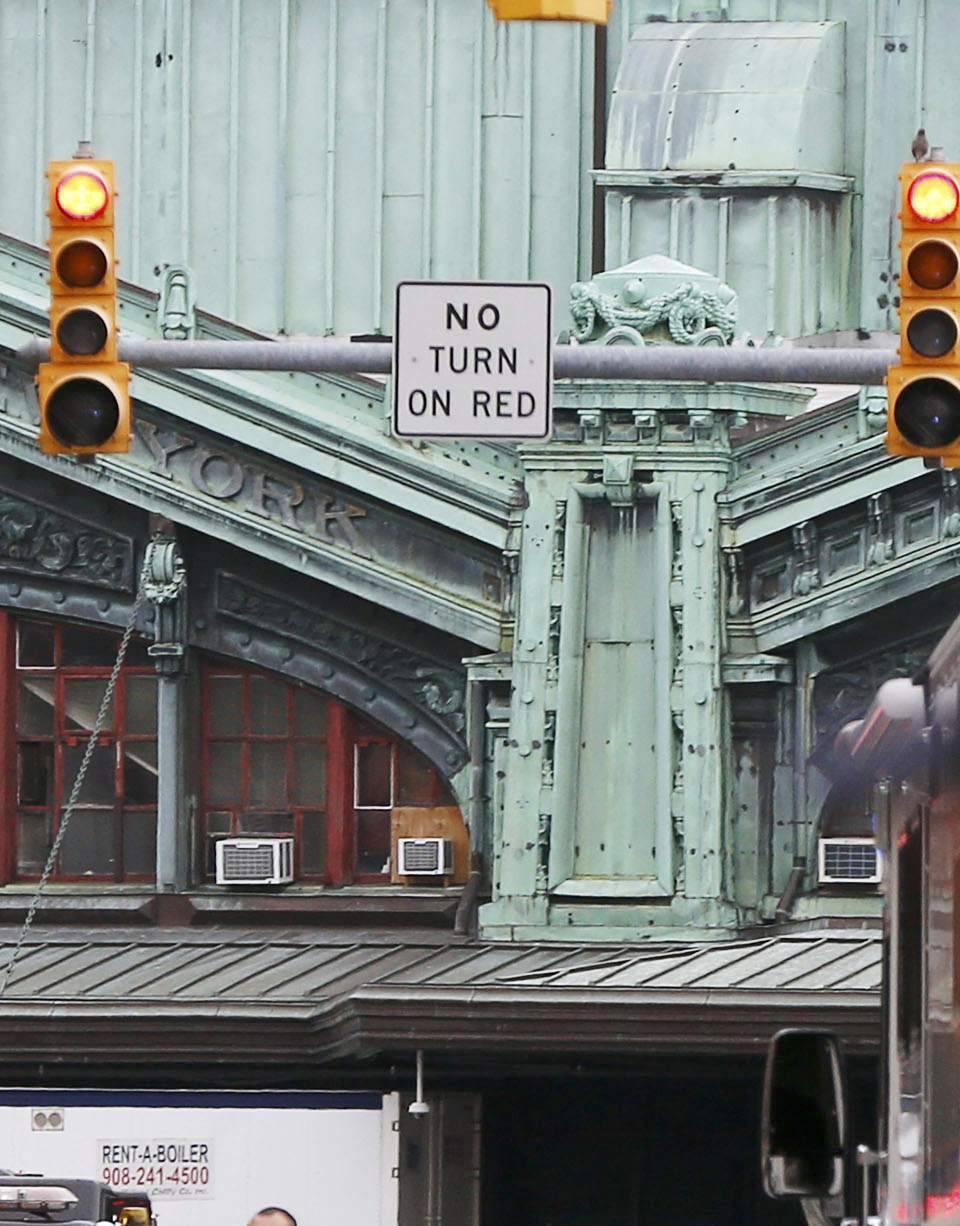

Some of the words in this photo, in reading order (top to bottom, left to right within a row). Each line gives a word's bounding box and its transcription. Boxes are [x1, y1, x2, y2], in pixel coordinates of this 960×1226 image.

[446, 303, 500, 331] NO
[429, 346, 517, 374] TURN
[408, 389, 450, 417] ON
[472, 390, 536, 418] RED
[137, 418, 373, 562] YORK
[102, 1144, 209, 1164] RENT-A-BOILER
[102, 1166, 209, 1186] 908-241-4500
